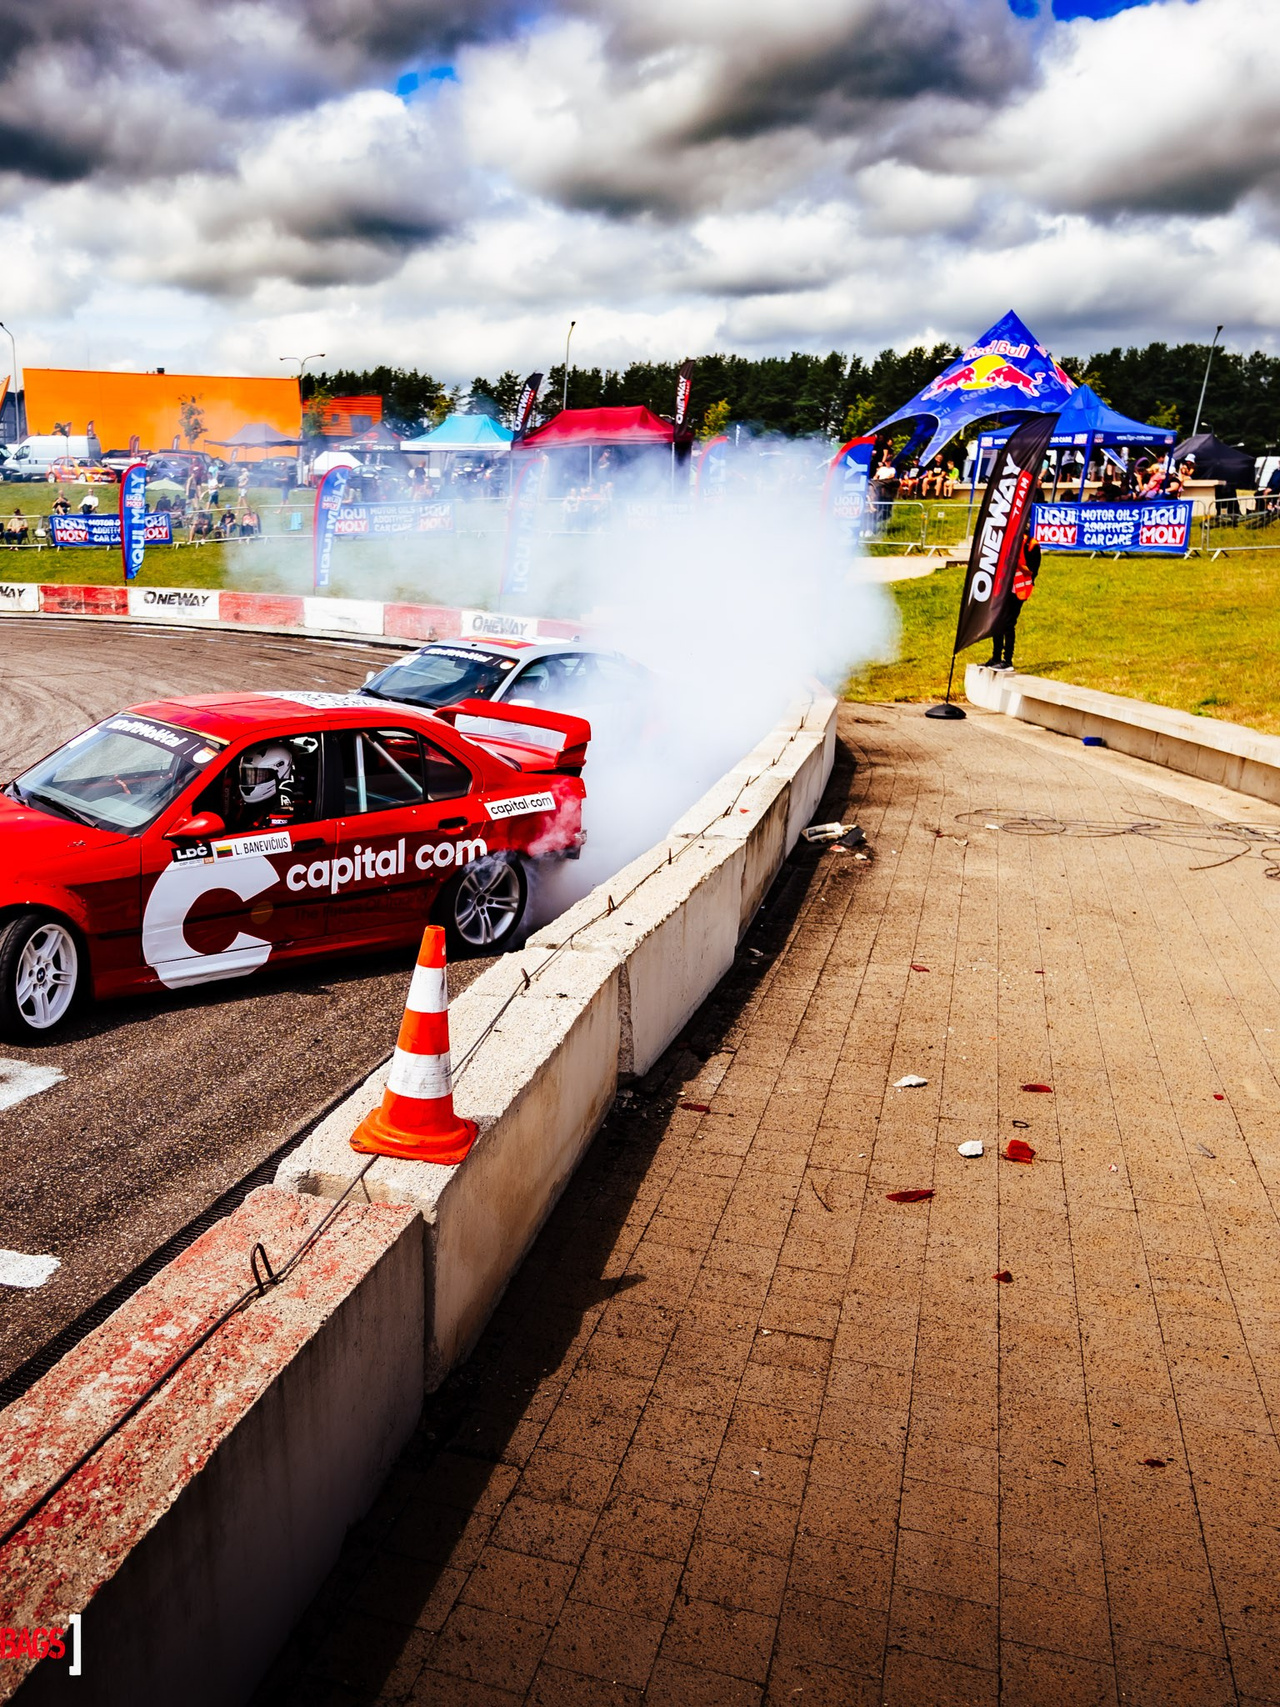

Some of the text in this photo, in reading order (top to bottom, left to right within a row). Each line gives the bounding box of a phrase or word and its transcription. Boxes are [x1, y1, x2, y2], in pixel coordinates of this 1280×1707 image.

[962, 341, 998, 361] Red
[996, 340, 1030, 359] Bull
[1012, 477, 1030, 521] TEAM
[1038, 508, 1076, 525] LIQUI
[1081, 509, 1139, 521] MOTOR OILS
[1143, 507, 1186, 525] LIQUI
[55, 519, 86, 530] LIQUI
[144, 527, 168, 538] OLY
[972, 453, 1021, 603] ONEWAY
[1083, 522, 1134, 533] ADDITIVES
[56, 530, 88, 541] MOLY
[1037, 526, 1076, 543] MOLY
[1083, 533, 1132, 545] CAR CARE
[1142, 526, 1186, 544] MOLY
[176, 844, 208, 860] LDČ
[235, 837, 289, 856] L. BANEVIČIUS
